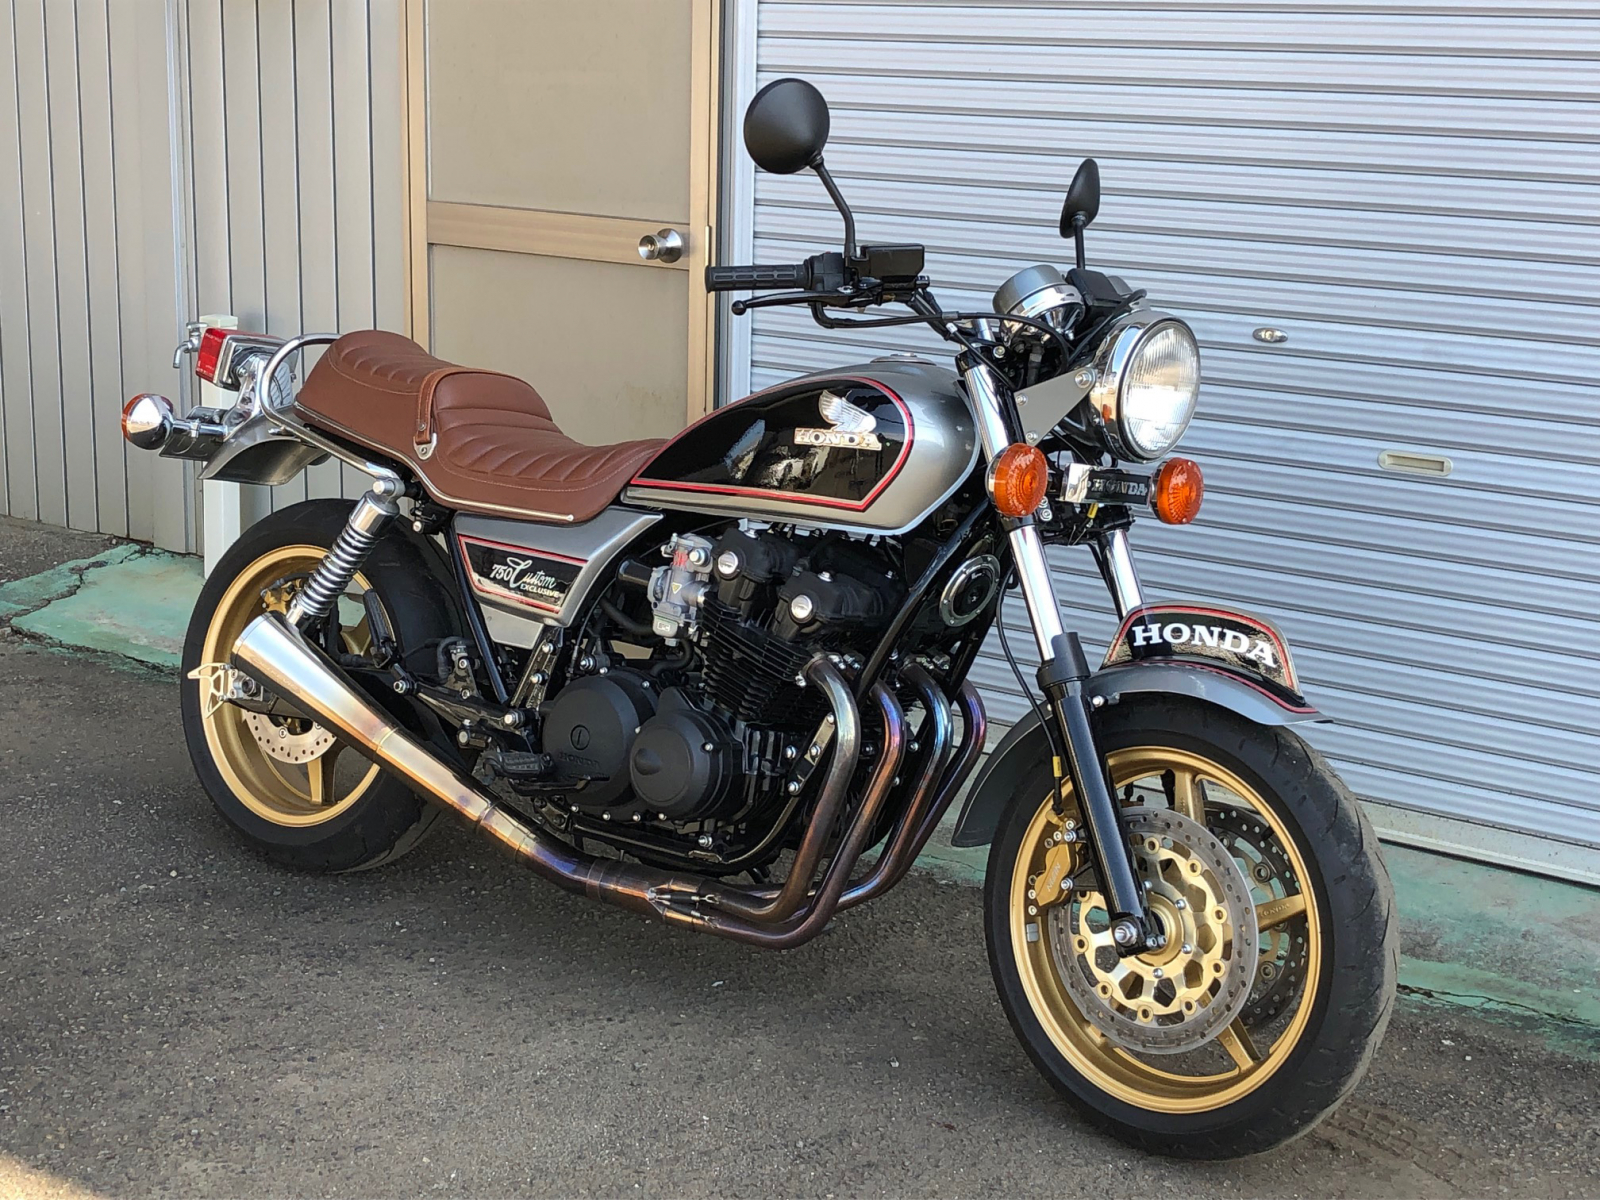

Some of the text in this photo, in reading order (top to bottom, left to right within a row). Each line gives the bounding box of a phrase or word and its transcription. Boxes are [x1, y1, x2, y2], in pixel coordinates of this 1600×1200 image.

[794, 428, 881, 450] HONDA
[1091, 478, 1148, 496] HONDA
[489, 556, 557, 589] 750 Custom
[520, 583, 561, 598] EXCLUSIVE
[1131, 623, 1278, 668] HONDA
